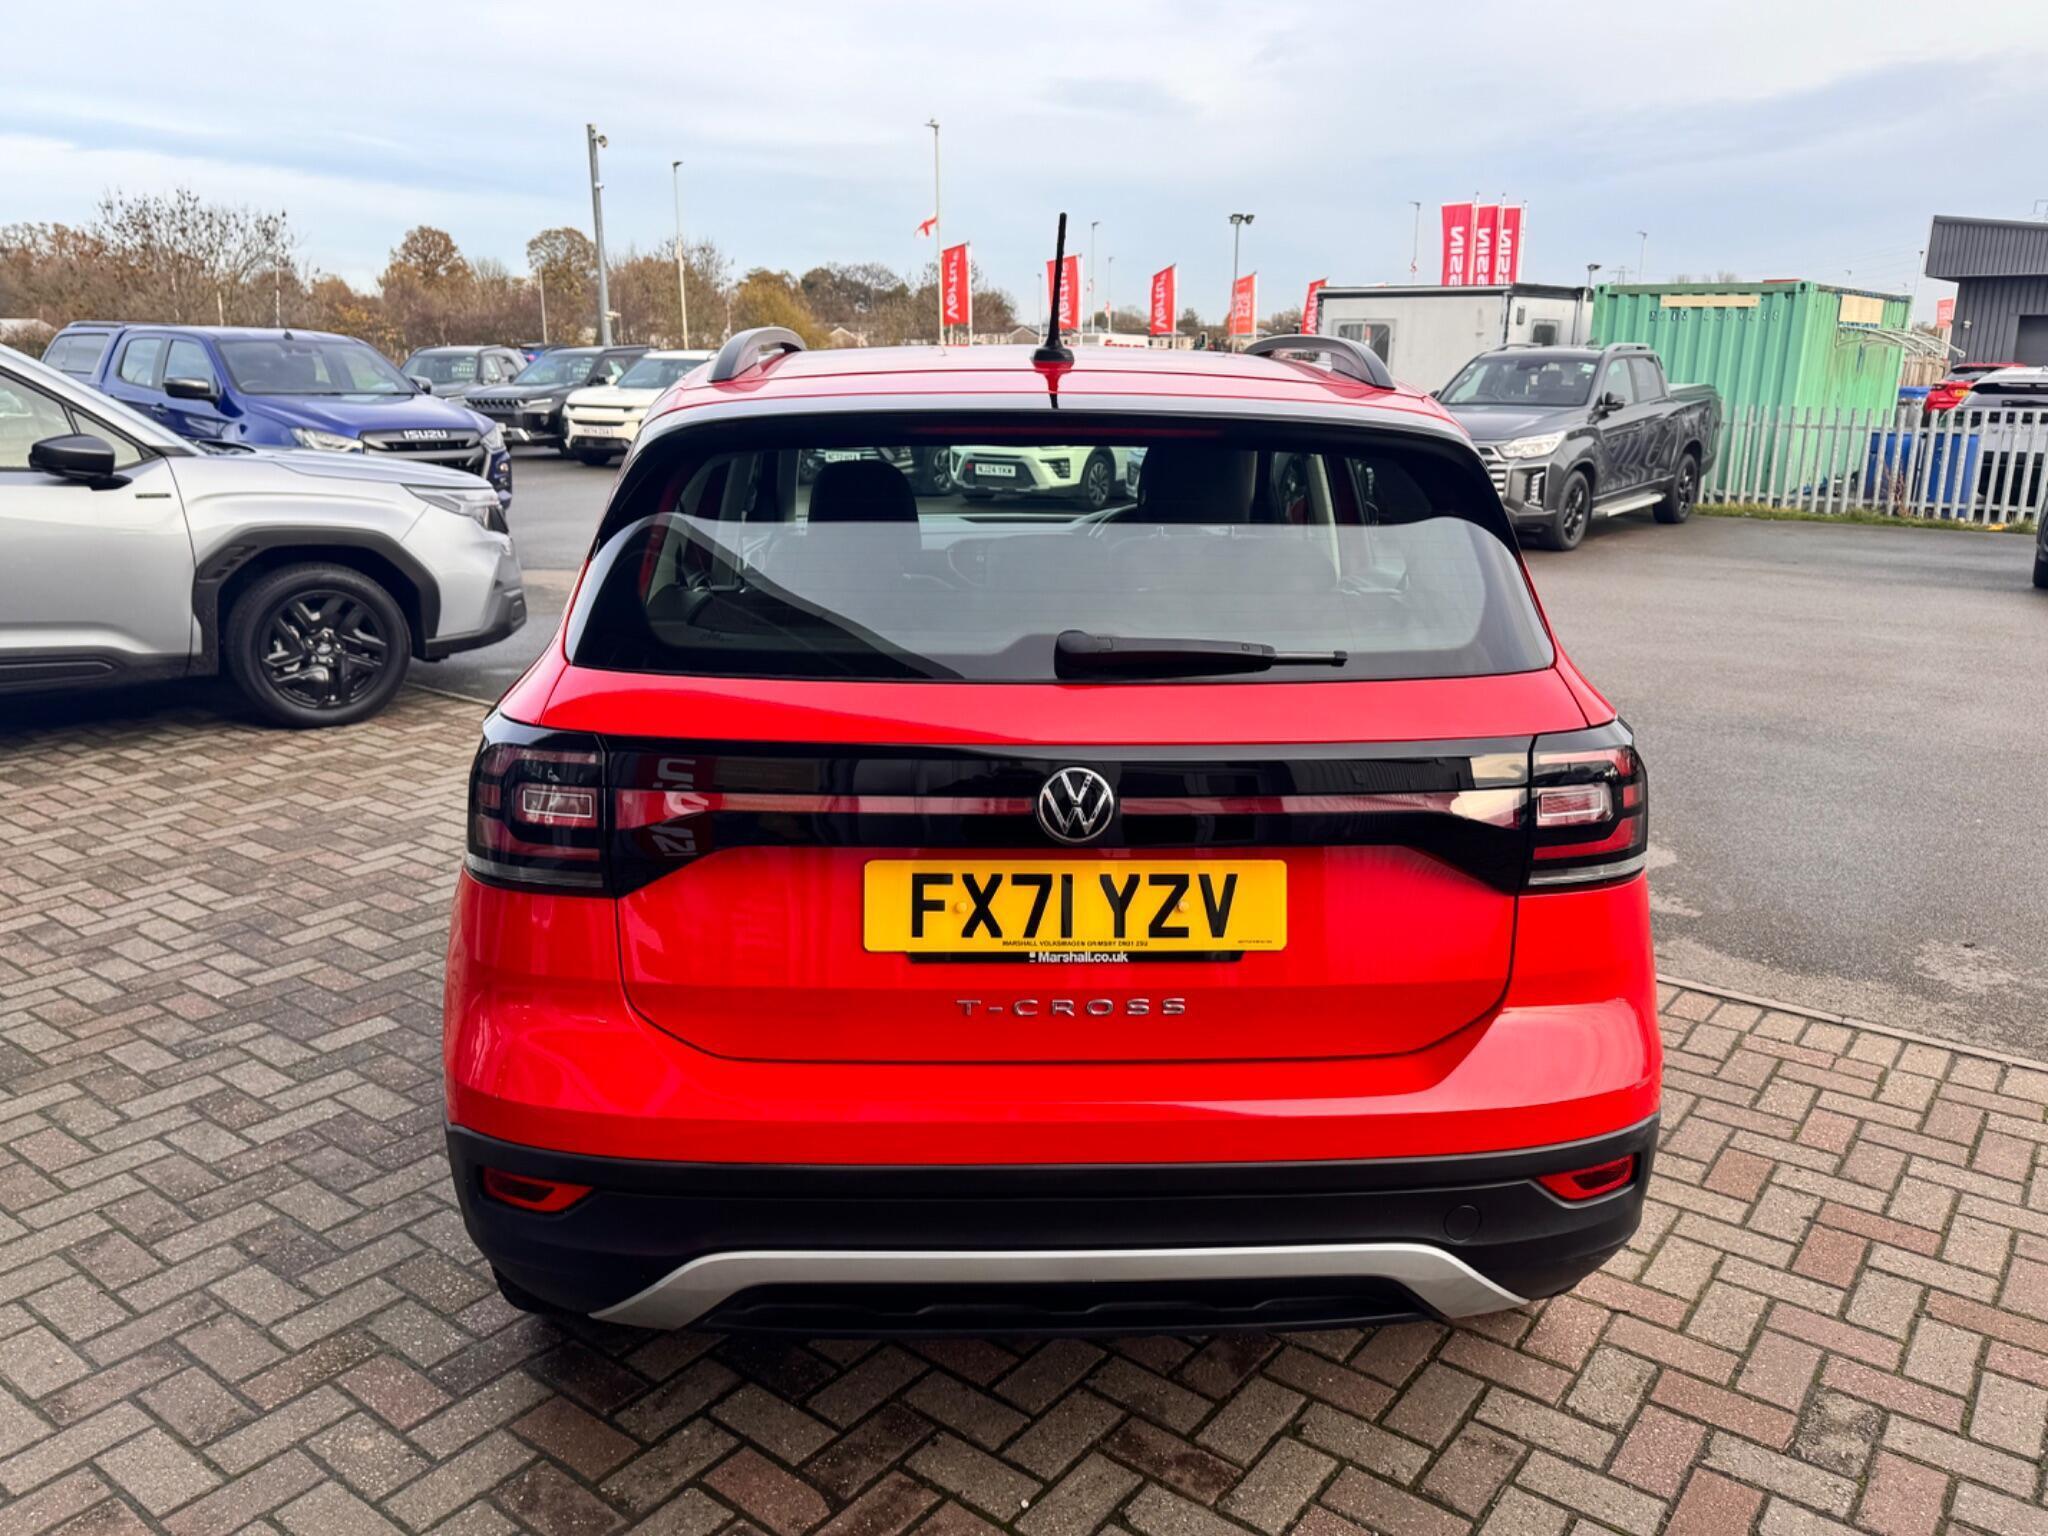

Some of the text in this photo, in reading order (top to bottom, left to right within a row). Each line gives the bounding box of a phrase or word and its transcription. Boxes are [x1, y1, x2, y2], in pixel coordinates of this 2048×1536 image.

[403, 429, 449, 440] ISUZU
[911, 872, 1239, 938] FX71 YZV
[1037, 951, 1129, 963] Marshall.co.uk
[956, 998, 1186, 1016] T-CROSS
